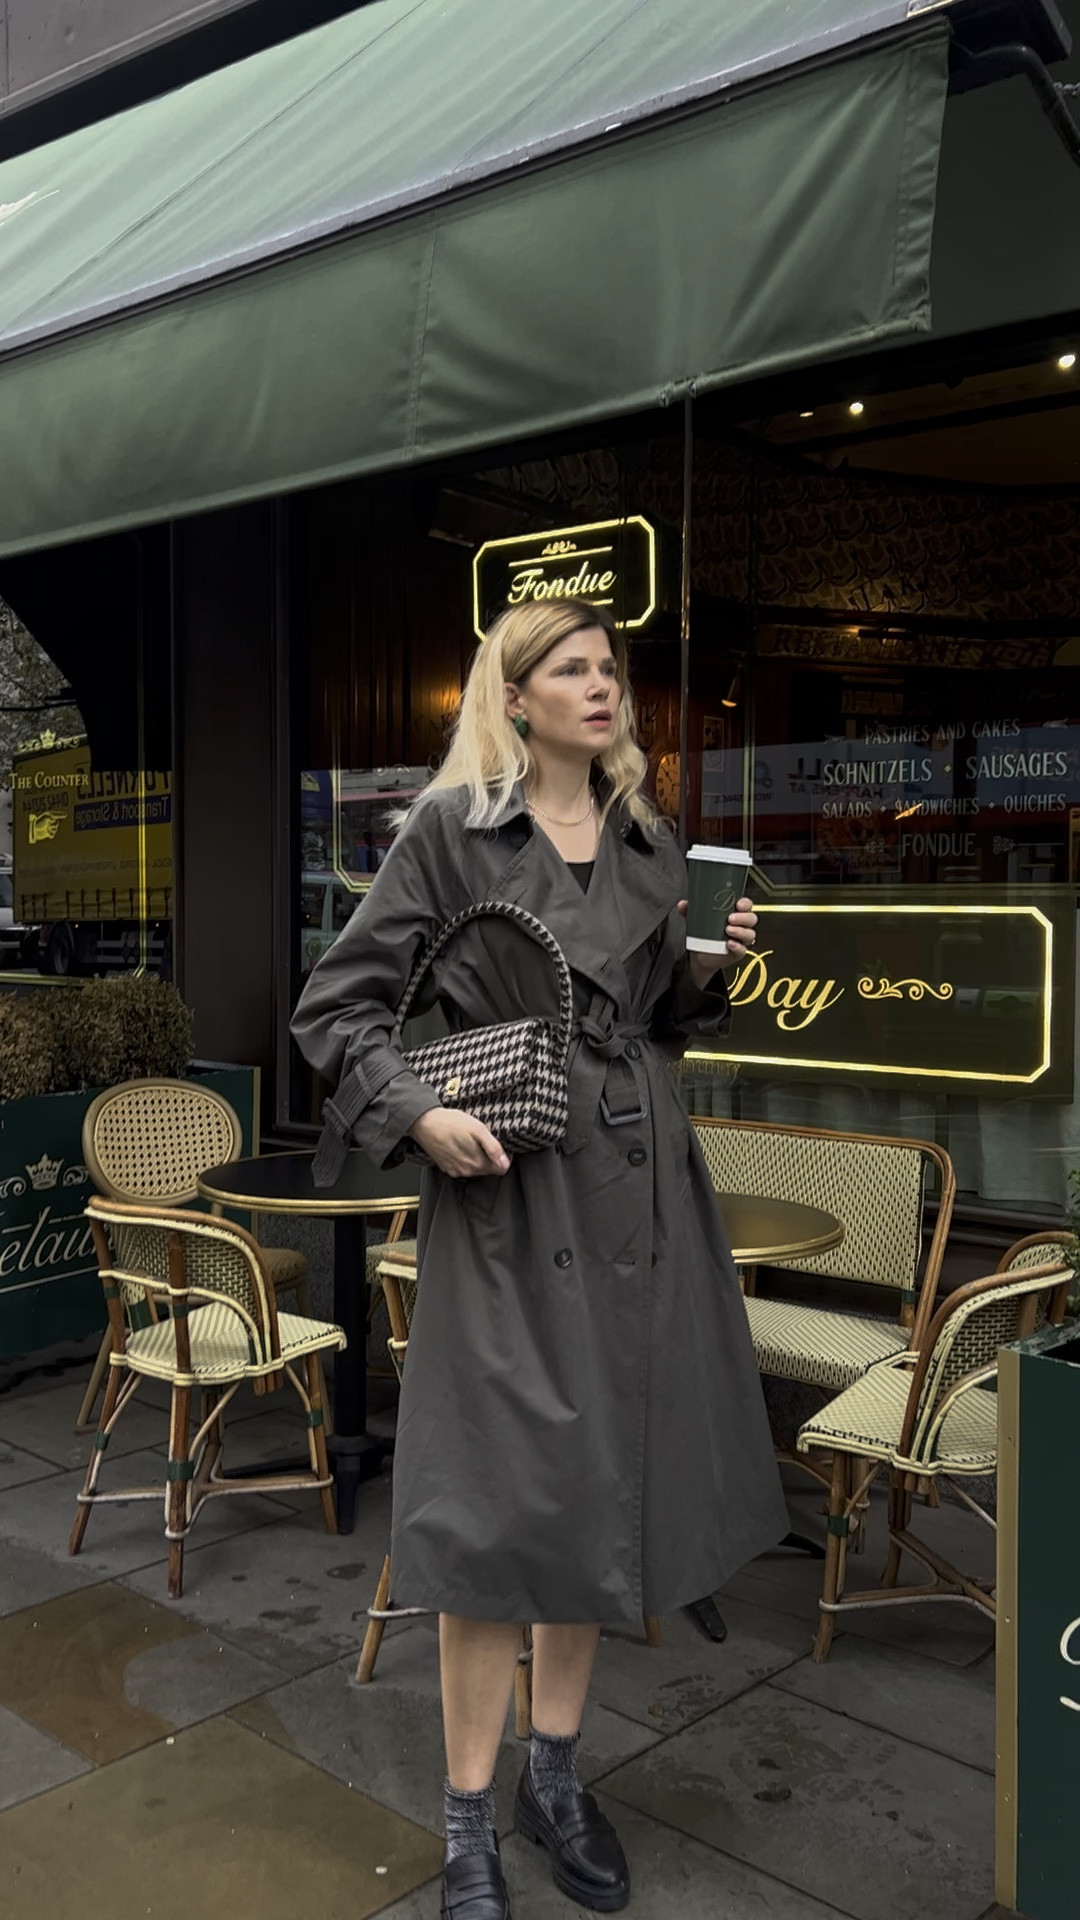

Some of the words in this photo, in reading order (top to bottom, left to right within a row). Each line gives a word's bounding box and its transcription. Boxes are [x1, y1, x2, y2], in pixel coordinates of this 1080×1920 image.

[507, 560, 617, 604] Fondue
[865, 723, 930, 745] PASTRIES
[936, 722, 966, 742] AND
[972, 718, 1021, 738] CAKES
[9, 772, 33, 789] THE
[34, 770, 89, 789] COUNTER
[823, 758, 933, 786] SCHNITZELS
[965, 751, 1068, 780] SAUSAGES
[822, 800, 873, 820] SALADS
[1003, 793, 1067, 814] QUICHES
[901, 832, 976, 858] FONDUE
[727, 949, 845, 1031] Day
